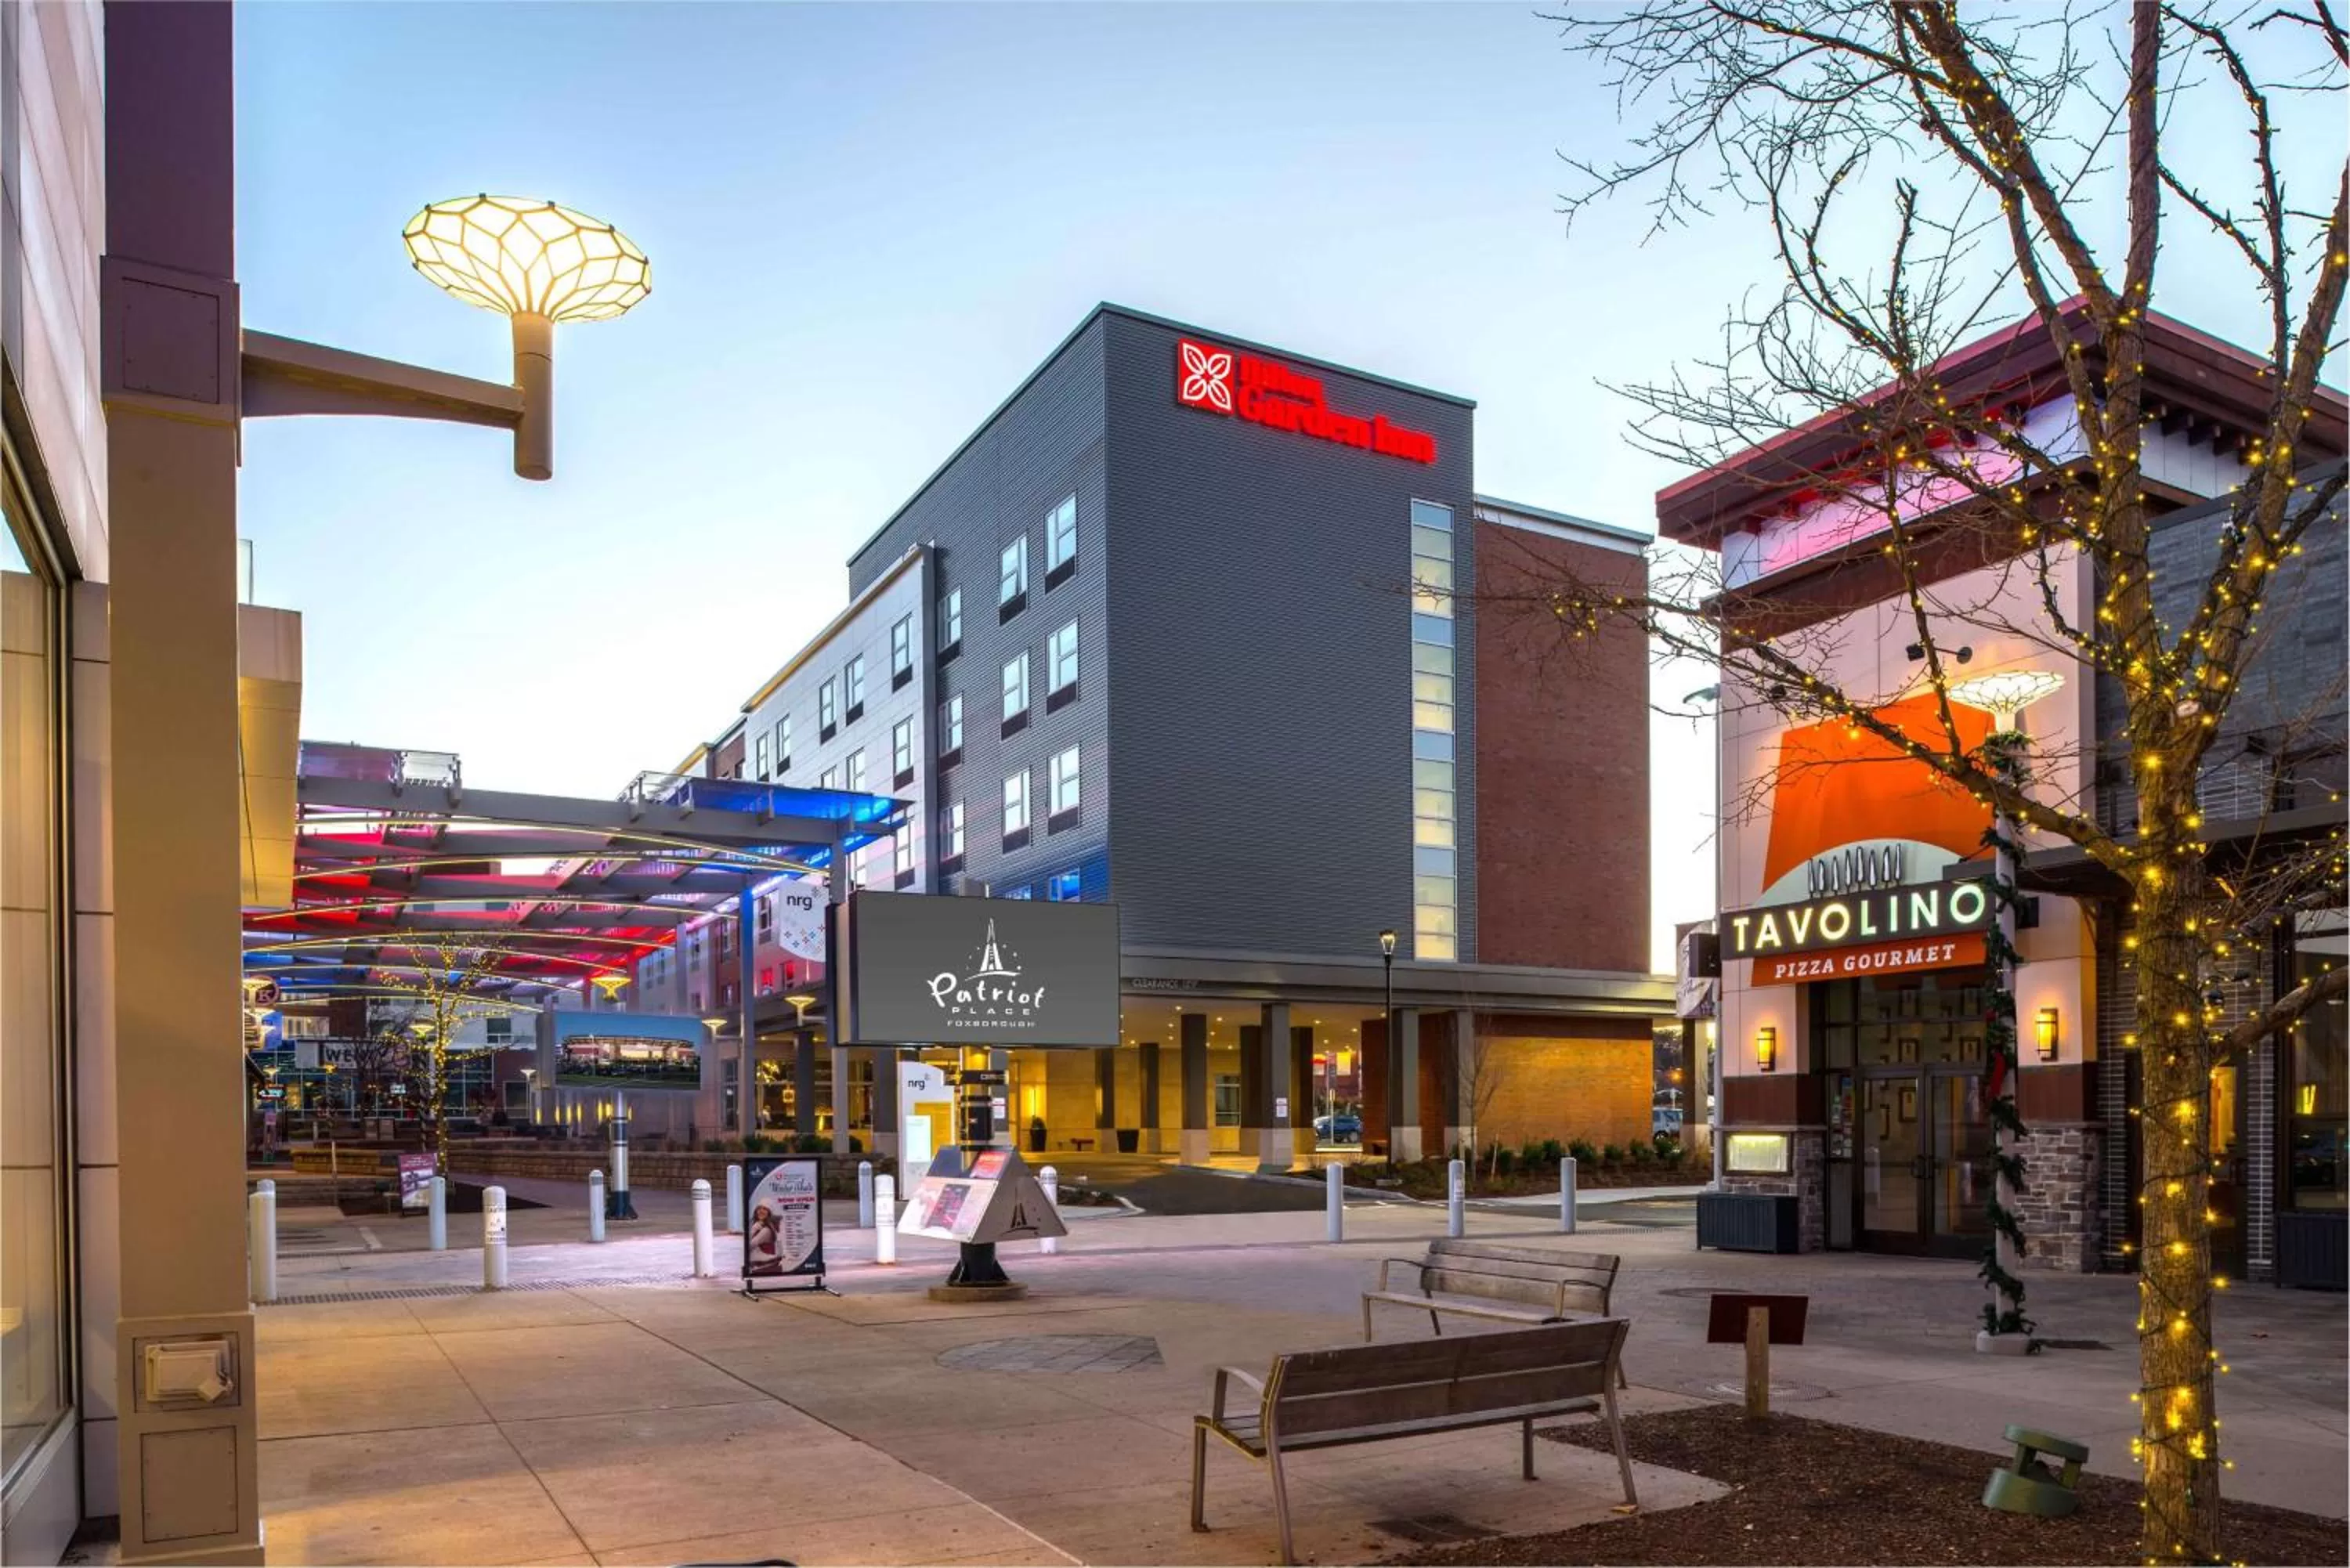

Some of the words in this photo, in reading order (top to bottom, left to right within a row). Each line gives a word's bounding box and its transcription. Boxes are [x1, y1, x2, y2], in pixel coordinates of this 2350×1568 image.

[1238, 384, 1372, 450] Garden
[786, 894, 812, 911] nrg
[1733, 883, 1986, 952] TAVOLINO
[1774, 957, 1835, 978] PIZZA
[1844, 944, 1956, 972] GOURMET
[927, 972, 1046, 1008] Patriot
[952, 1006, 1030, 1016] PLACE
[947, 1020, 1036, 1028] FOXBOROUGH
[908, 1078, 926, 1090] nrg
